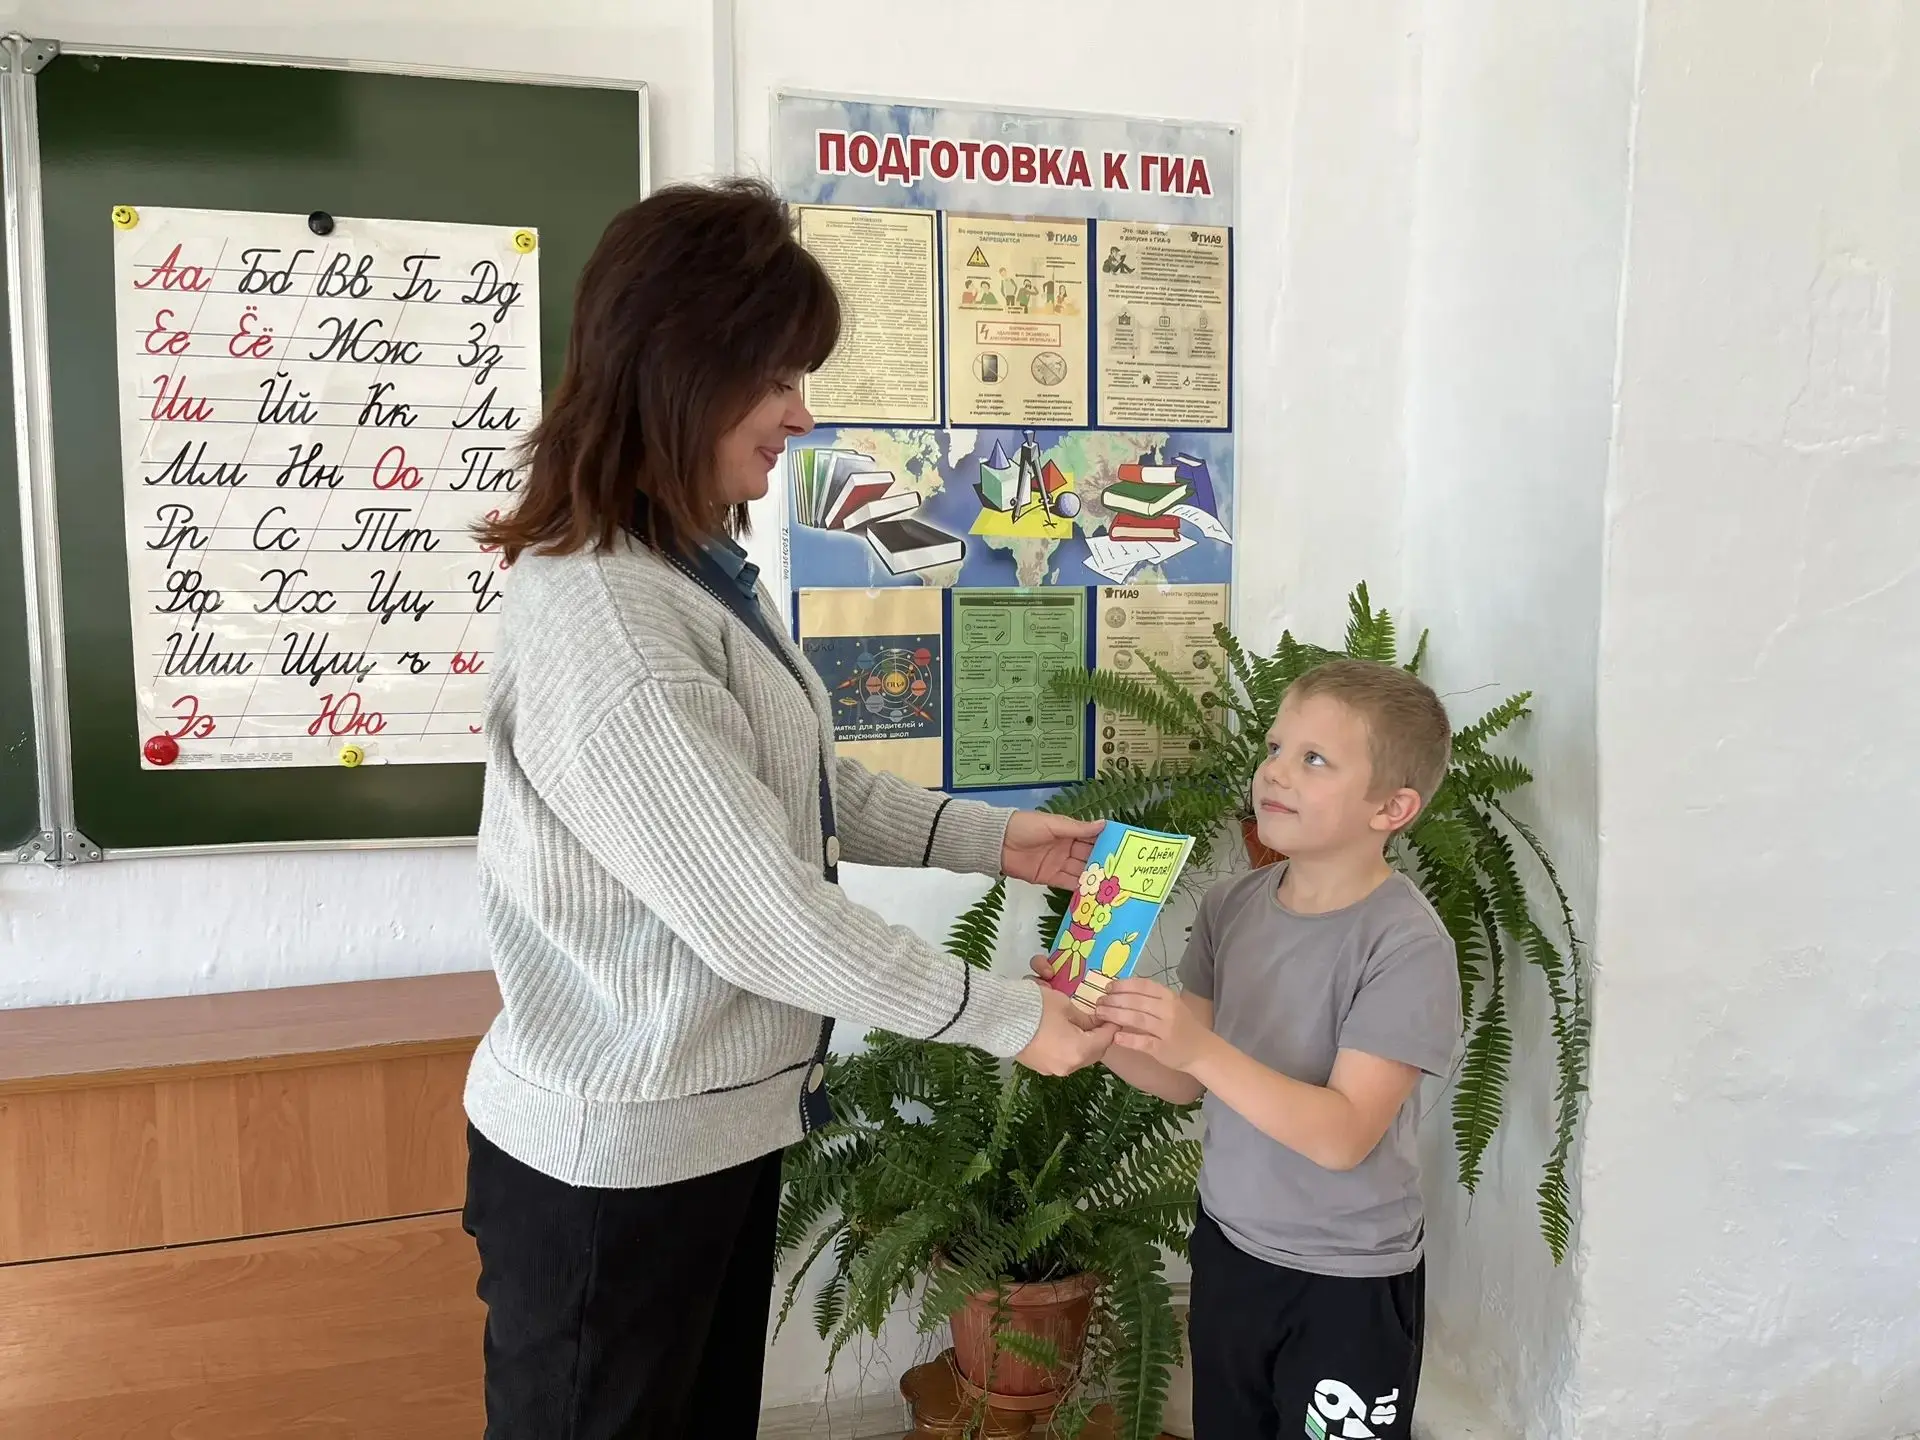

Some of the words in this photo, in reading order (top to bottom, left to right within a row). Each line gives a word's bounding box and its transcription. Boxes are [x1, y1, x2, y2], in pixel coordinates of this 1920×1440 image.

[817, 130, 1093, 189] ПОДГОТОВКА
[1102, 151, 1129, 191] К
[1139, 154, 1212, 196] ГИА
[1055, 233, 1078, 243] ГИА9
[1200, 234, 1222, 244] ГИА9
[133, 244, 211, 292] Аа
[238, 248, 315, 295] Бб
[316, 252, 374, 299] Вв
[393, 256, 441, 302] Гг
[461, 260, 521, 323] Дд
[145, 309, 190, 356] Ее
[228, 305, 274, 358] Ёё
[309, 317, 422, 365] Жж
[457, 322, 503, 385] Зз
[153, 374, 215, 422] Ии
[258, 371, 319, 425] Йй
[358, 382, 419, 428] Кк
[452, 386, 521, 430] Лл
[145, 441, 248, 487] Мм
[276, 442, 345, 489] Нн
[372, 446, 424, 491] Оо
[449, 447, 522, 492] Пп
[146, 503, 209, 569] Рр
[253, 506, 300, 551] Сс
[342, 507, 440, 552] Тт
[155, 569, 224, 631] Фф
[253, 569, 337, 614] Хх
[366, 570, 435, 625] Цц
[467, 570, 503, 614] Ч
[1114, 589, 1140, 599] ГИА9
[164, 632, 254, 677] Шш
[281, 631, 377, 688] Щщ
[164, 695, 216, 739] Ээ
[307, 692, 388, 737] Юю
[875, 720, 918, 731] родителей
[1130, 863, 1171, 878] учителя!
[1137, 846, 1147, 860] С
[1147, 846, 1174, 862] Днём
